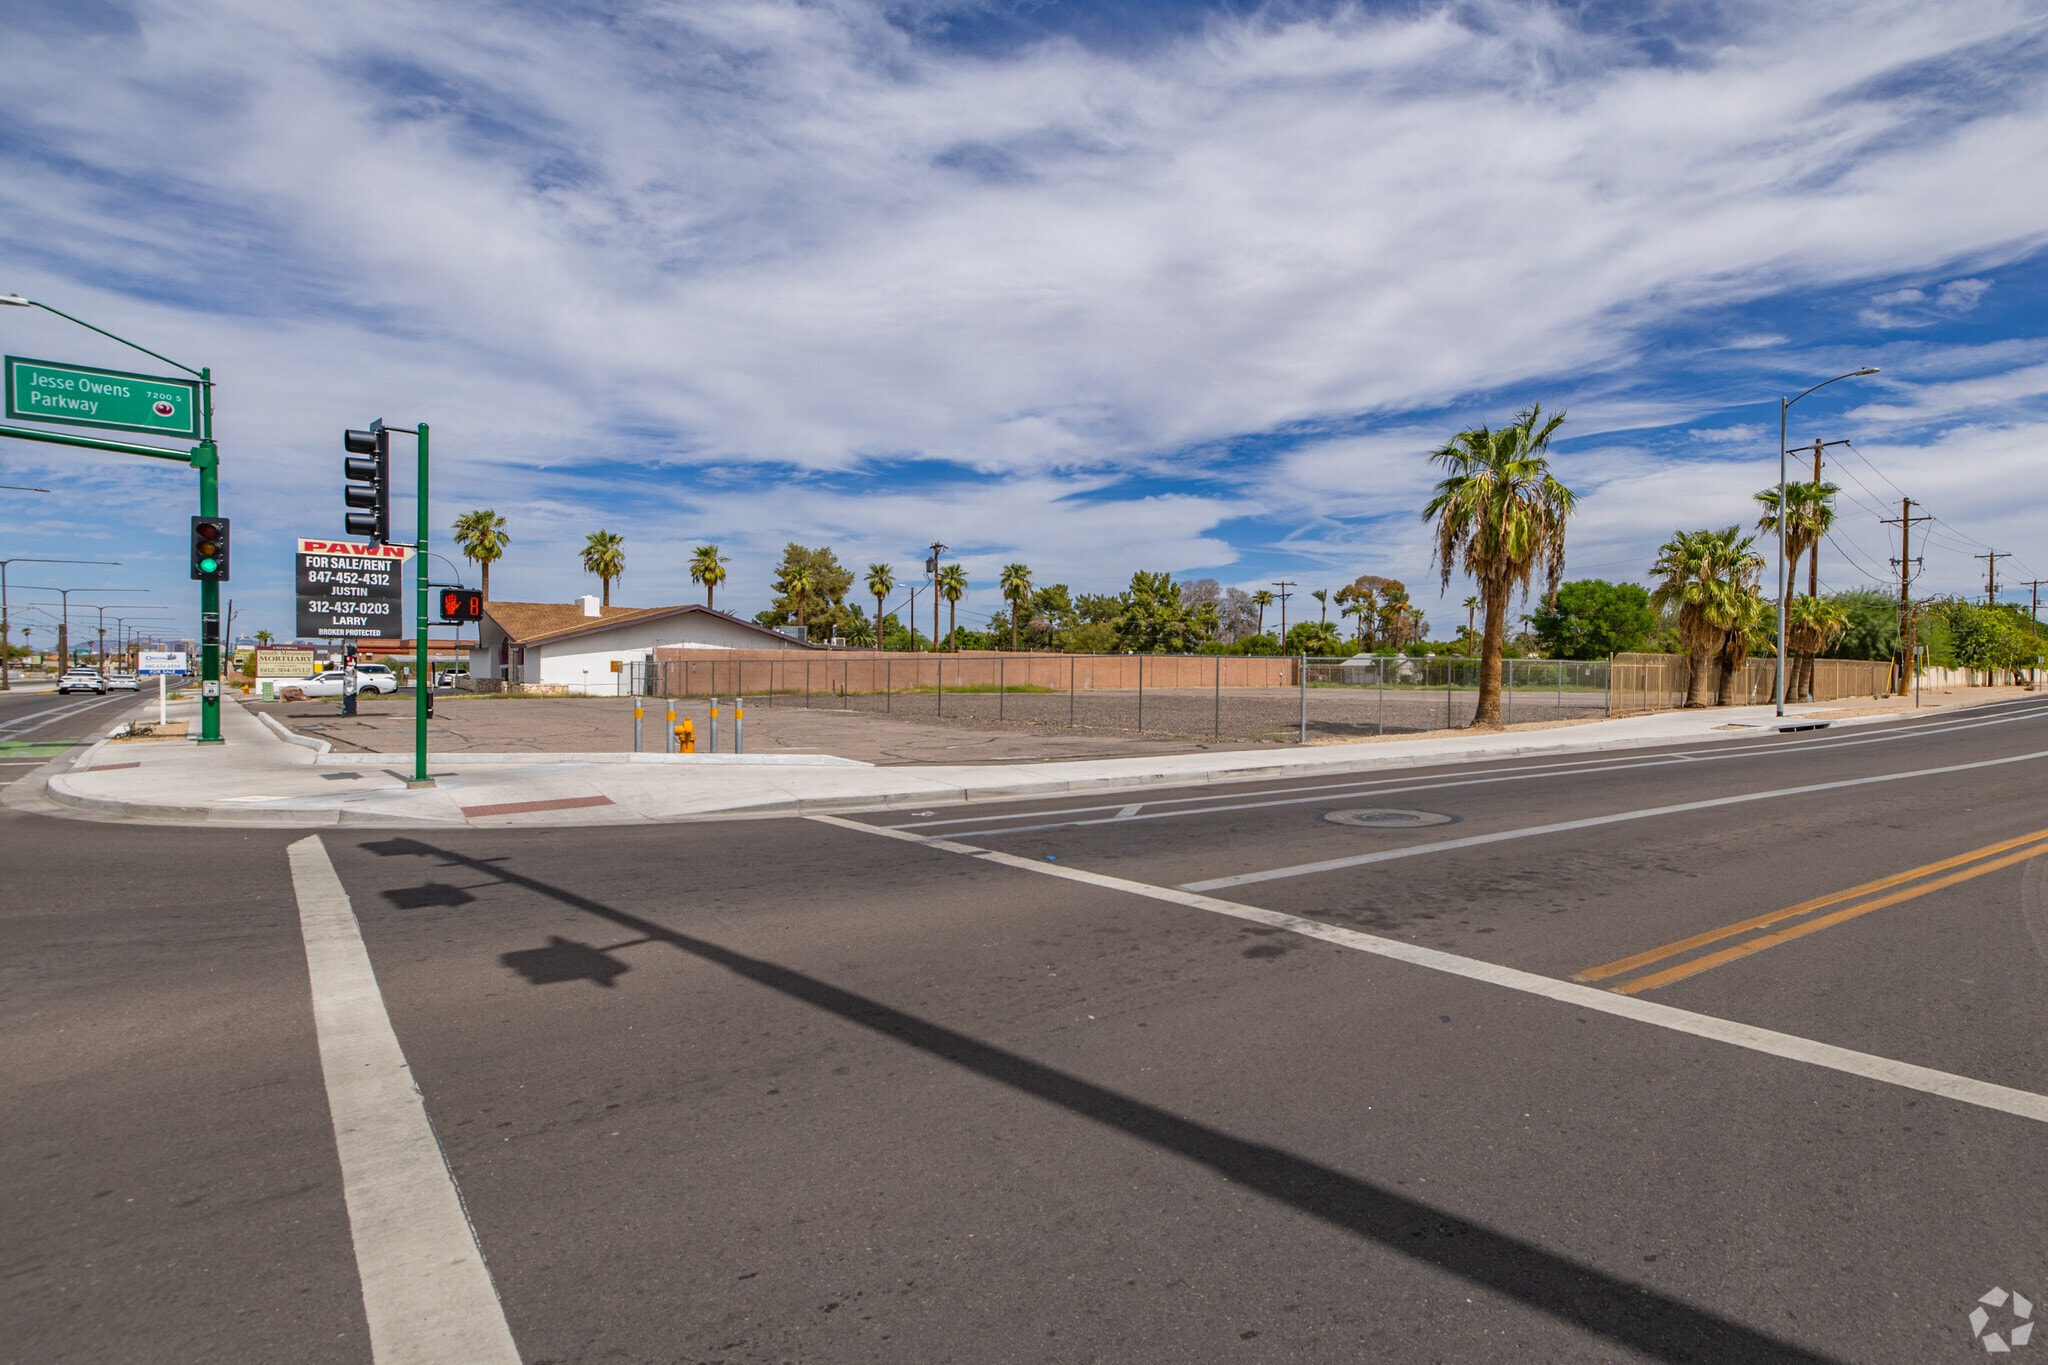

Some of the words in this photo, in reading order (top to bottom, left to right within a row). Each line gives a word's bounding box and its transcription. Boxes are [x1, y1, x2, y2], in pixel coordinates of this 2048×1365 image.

[31, 372, 74, 391] Jesse
[78, 378, 130, 398] Owens
[31, 391, 98, 415] Parkway
[146, 391, 172, 401] 7200
[304, 541, 405, 558] PAWN
[305, 556, 329, 568] FOR
[331, 557, 392, 571] SALE/RENT
[308, 571, 390, 586] 847-452-4312
[331, 586, 368, 597] JUSTIN
[308, 600, 390, 615] 312-437-0203
[470, 596, 479, 616] 8
[333, 616, 368, 626] LARRY
[346, 629, 381, 637] PROTECTED
